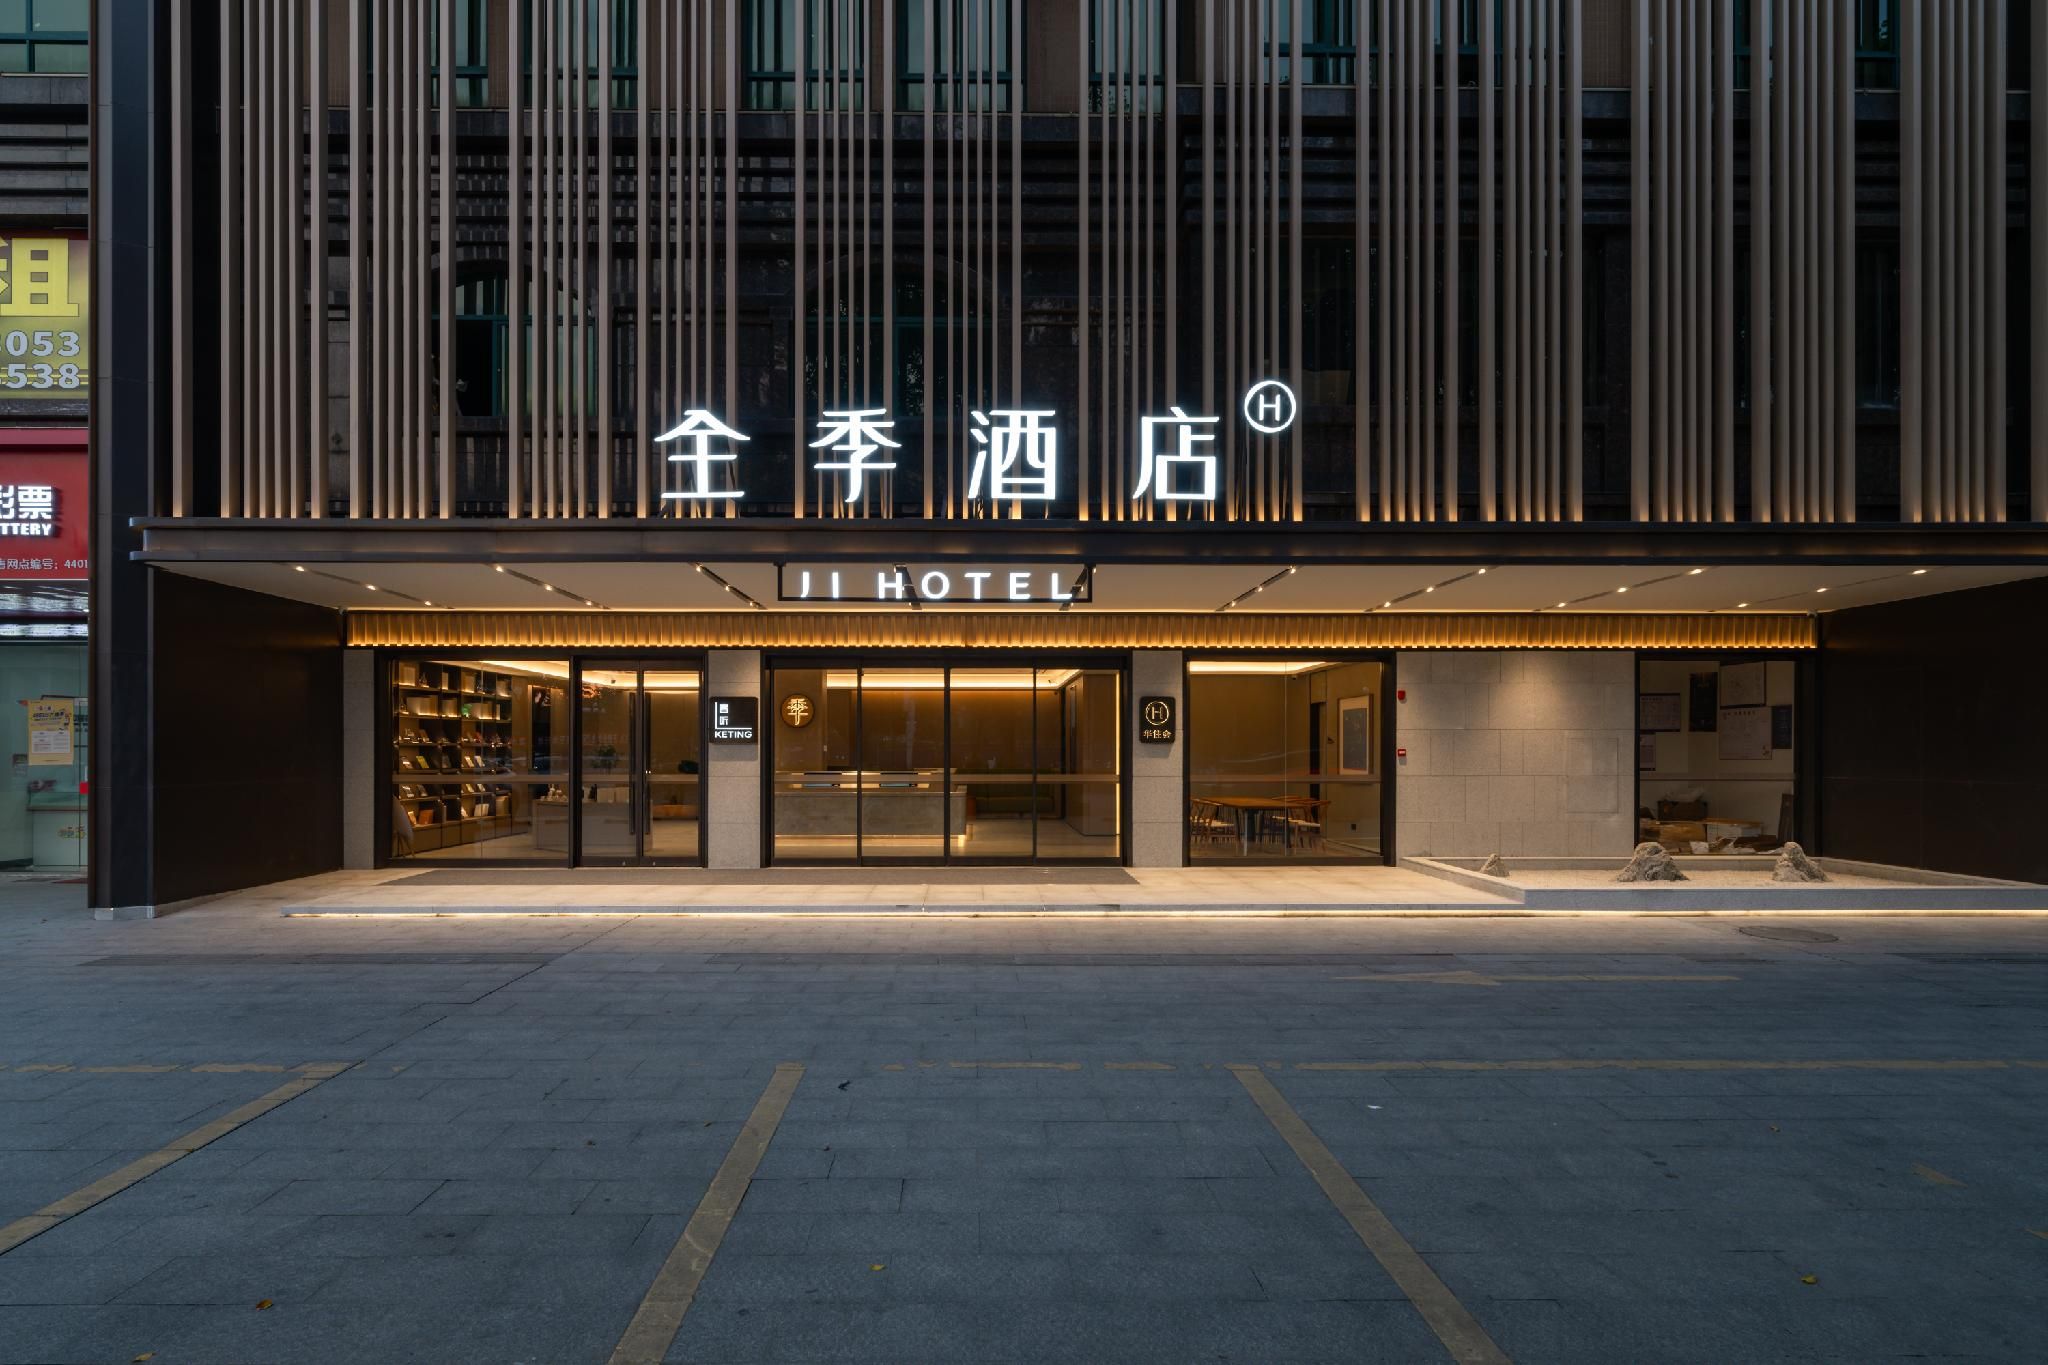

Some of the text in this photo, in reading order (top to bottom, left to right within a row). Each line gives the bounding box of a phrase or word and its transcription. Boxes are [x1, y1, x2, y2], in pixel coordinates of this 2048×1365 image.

[0, 331, 80, 357] 053
[0, 363, 80, 389] 538
[653, 405, 1220, 503] 全季酒店
[800, 570, 1074, 600] JI HOTEL
[714, 730, 753, 739] KETING
